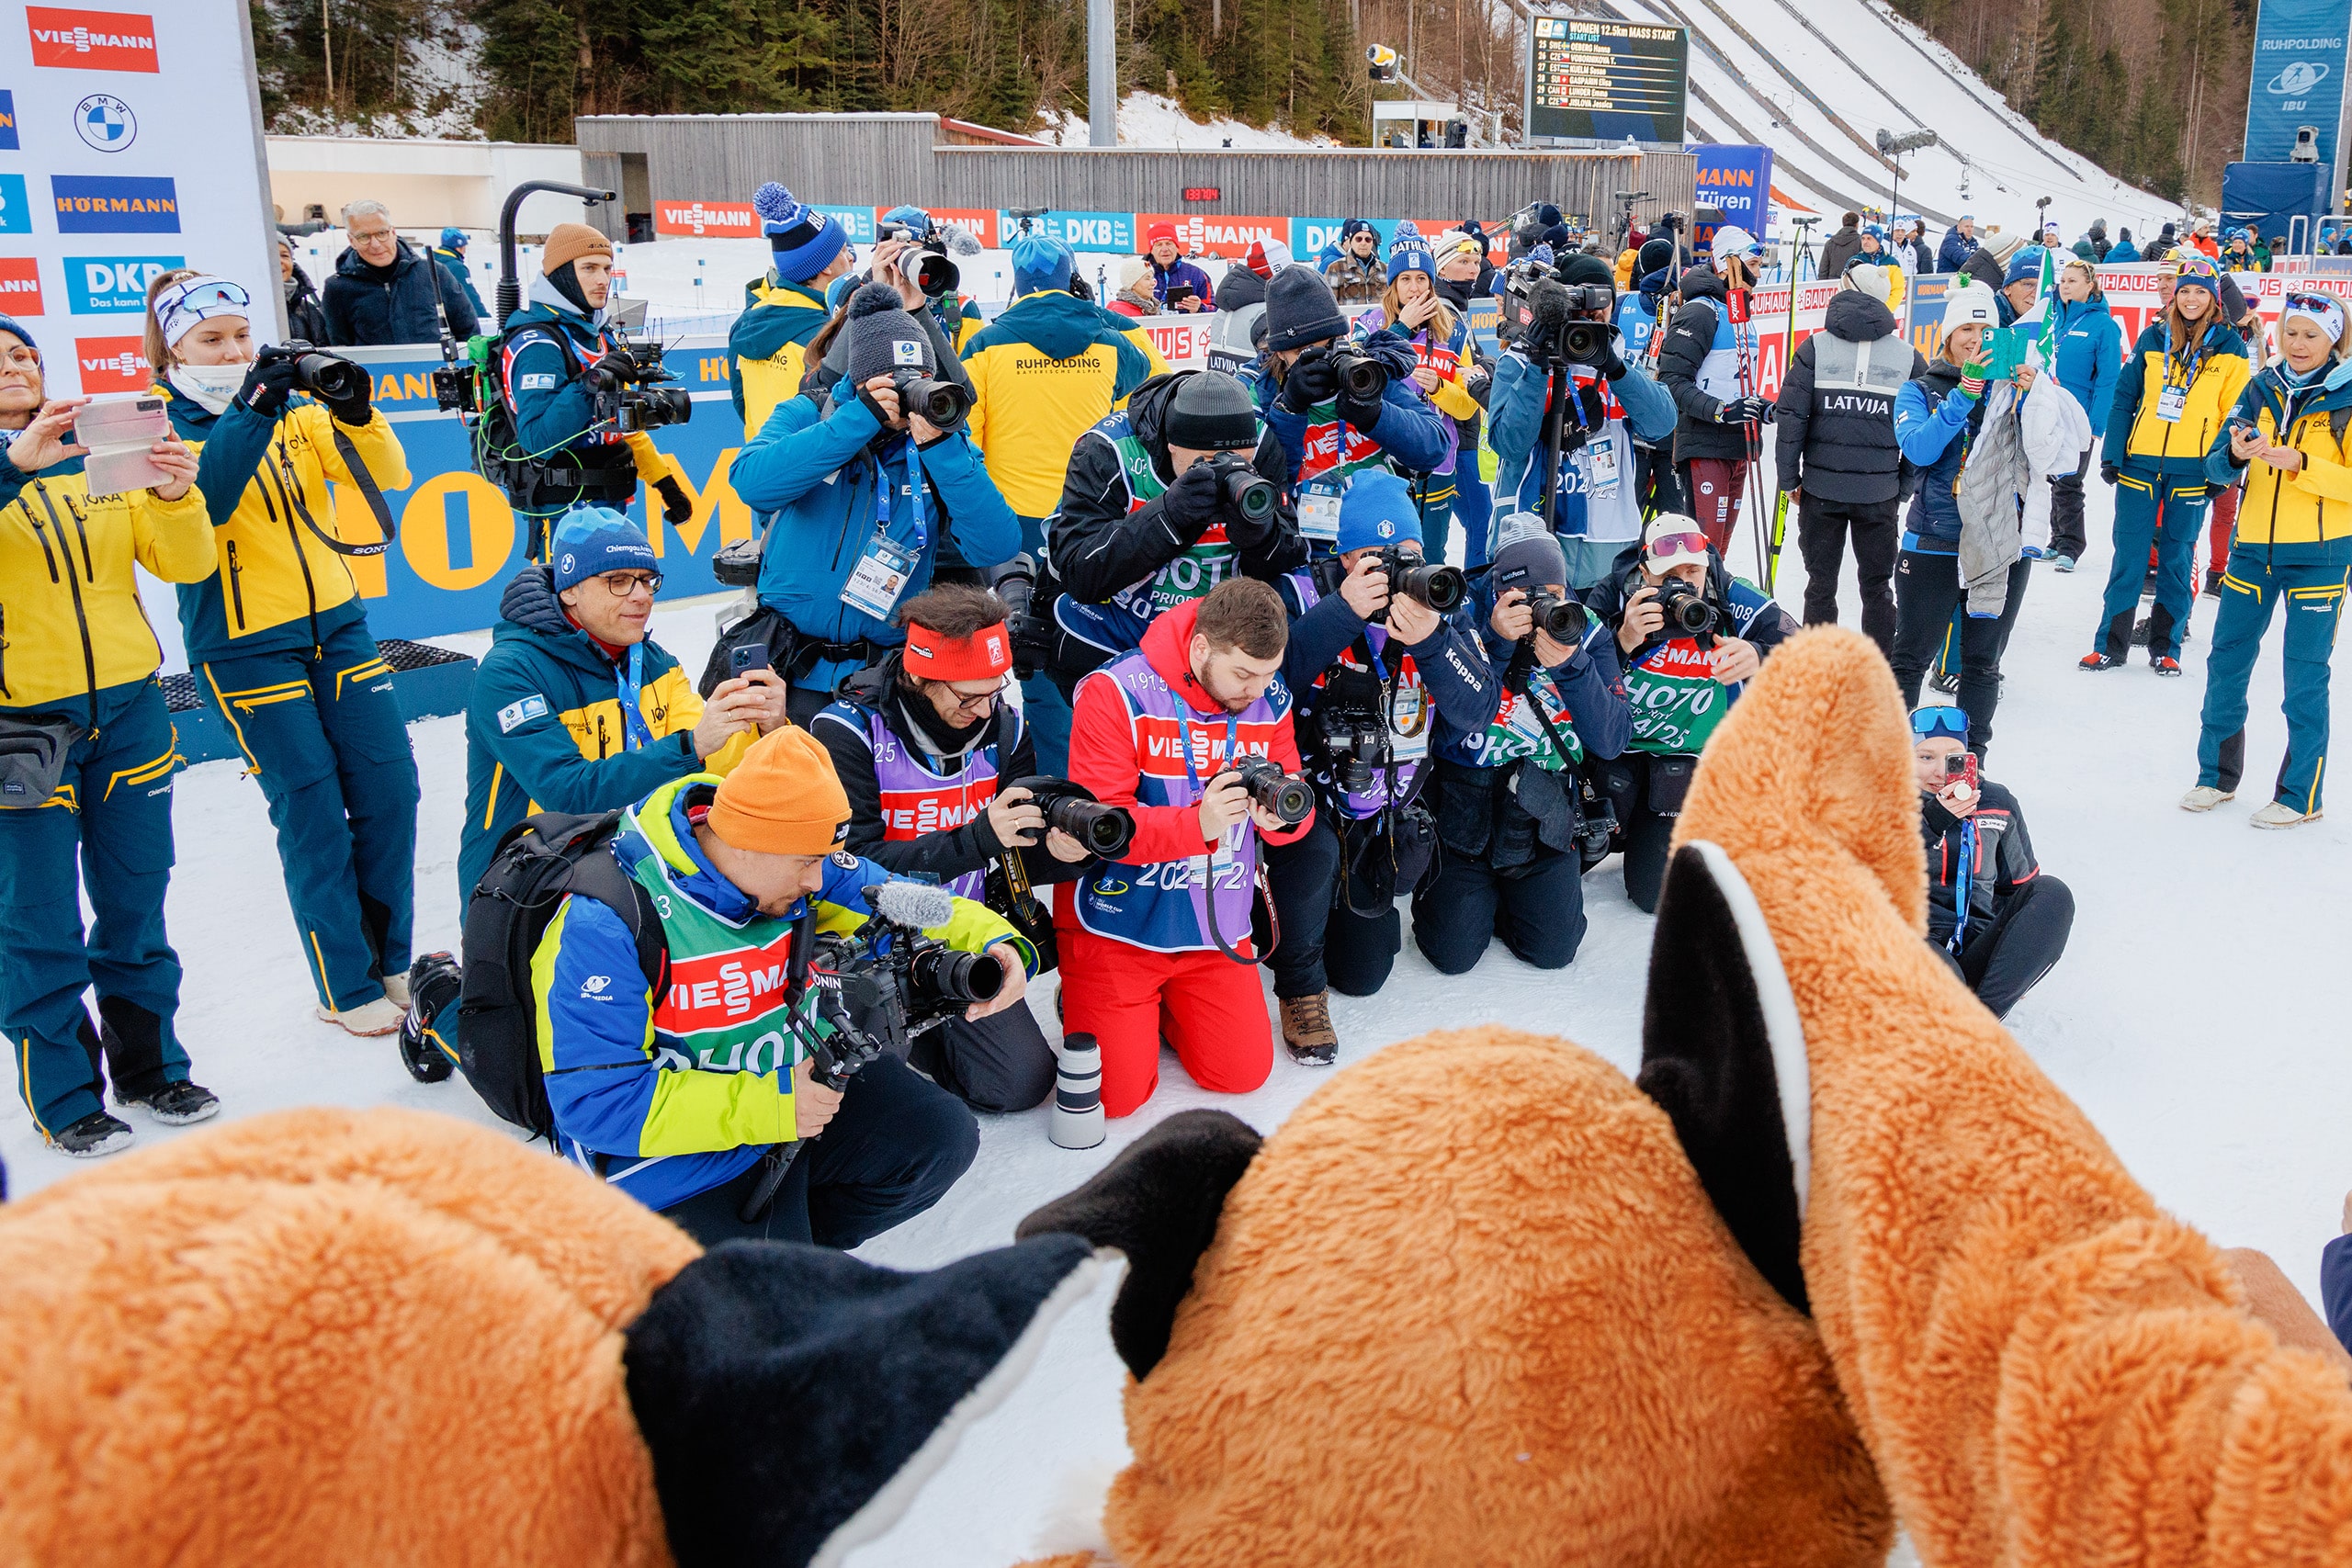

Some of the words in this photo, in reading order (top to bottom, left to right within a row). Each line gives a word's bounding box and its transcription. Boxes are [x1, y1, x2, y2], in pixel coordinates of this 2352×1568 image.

[33, 27, 153, 53] VIESSMANN
[1569, 22, 1600, 34] WOMEN
[1600, 25, 1628, 38] 12.5km
[1628, 27, 1651, 39] MASS
[1651, 29, 1677, 41] START
[1588, 34, 1600, 42] LIST
[2262, 38, 2342, 51] RUHPOLDING
[82, 96, 127, 114] BMW
[2281, 100, 2307, 111] IBU
[56, 196, 176, 213] HÖRMANN
[664, 203, 751, 234] VIESSMANN
[1002, 217, 1046, 243] DB
[1067, 219, 1112, 245] DKB
[90, 297, 111, 308] Das
[114, 296, 141, 308] kann
[82, 352, 151, 377] VIESSM
[1016, 357, 1101, 369] RUHPOLDING
[1825, 396, 1889, 415] LATVIJA
[1214, 436, 1259, 447] ziene
[353, 542, 390, 556] SONY
[1444, 647, 1483, 693] Kappa
[1148, 729, 1270, 771] VIESSMAN
[1095, 900, 1114, 911] WORLD
[915, 940, 929, 948] SONY
[669, 961, 788, 1016] IESSM
[811, 973, 842, 990] ONIN
